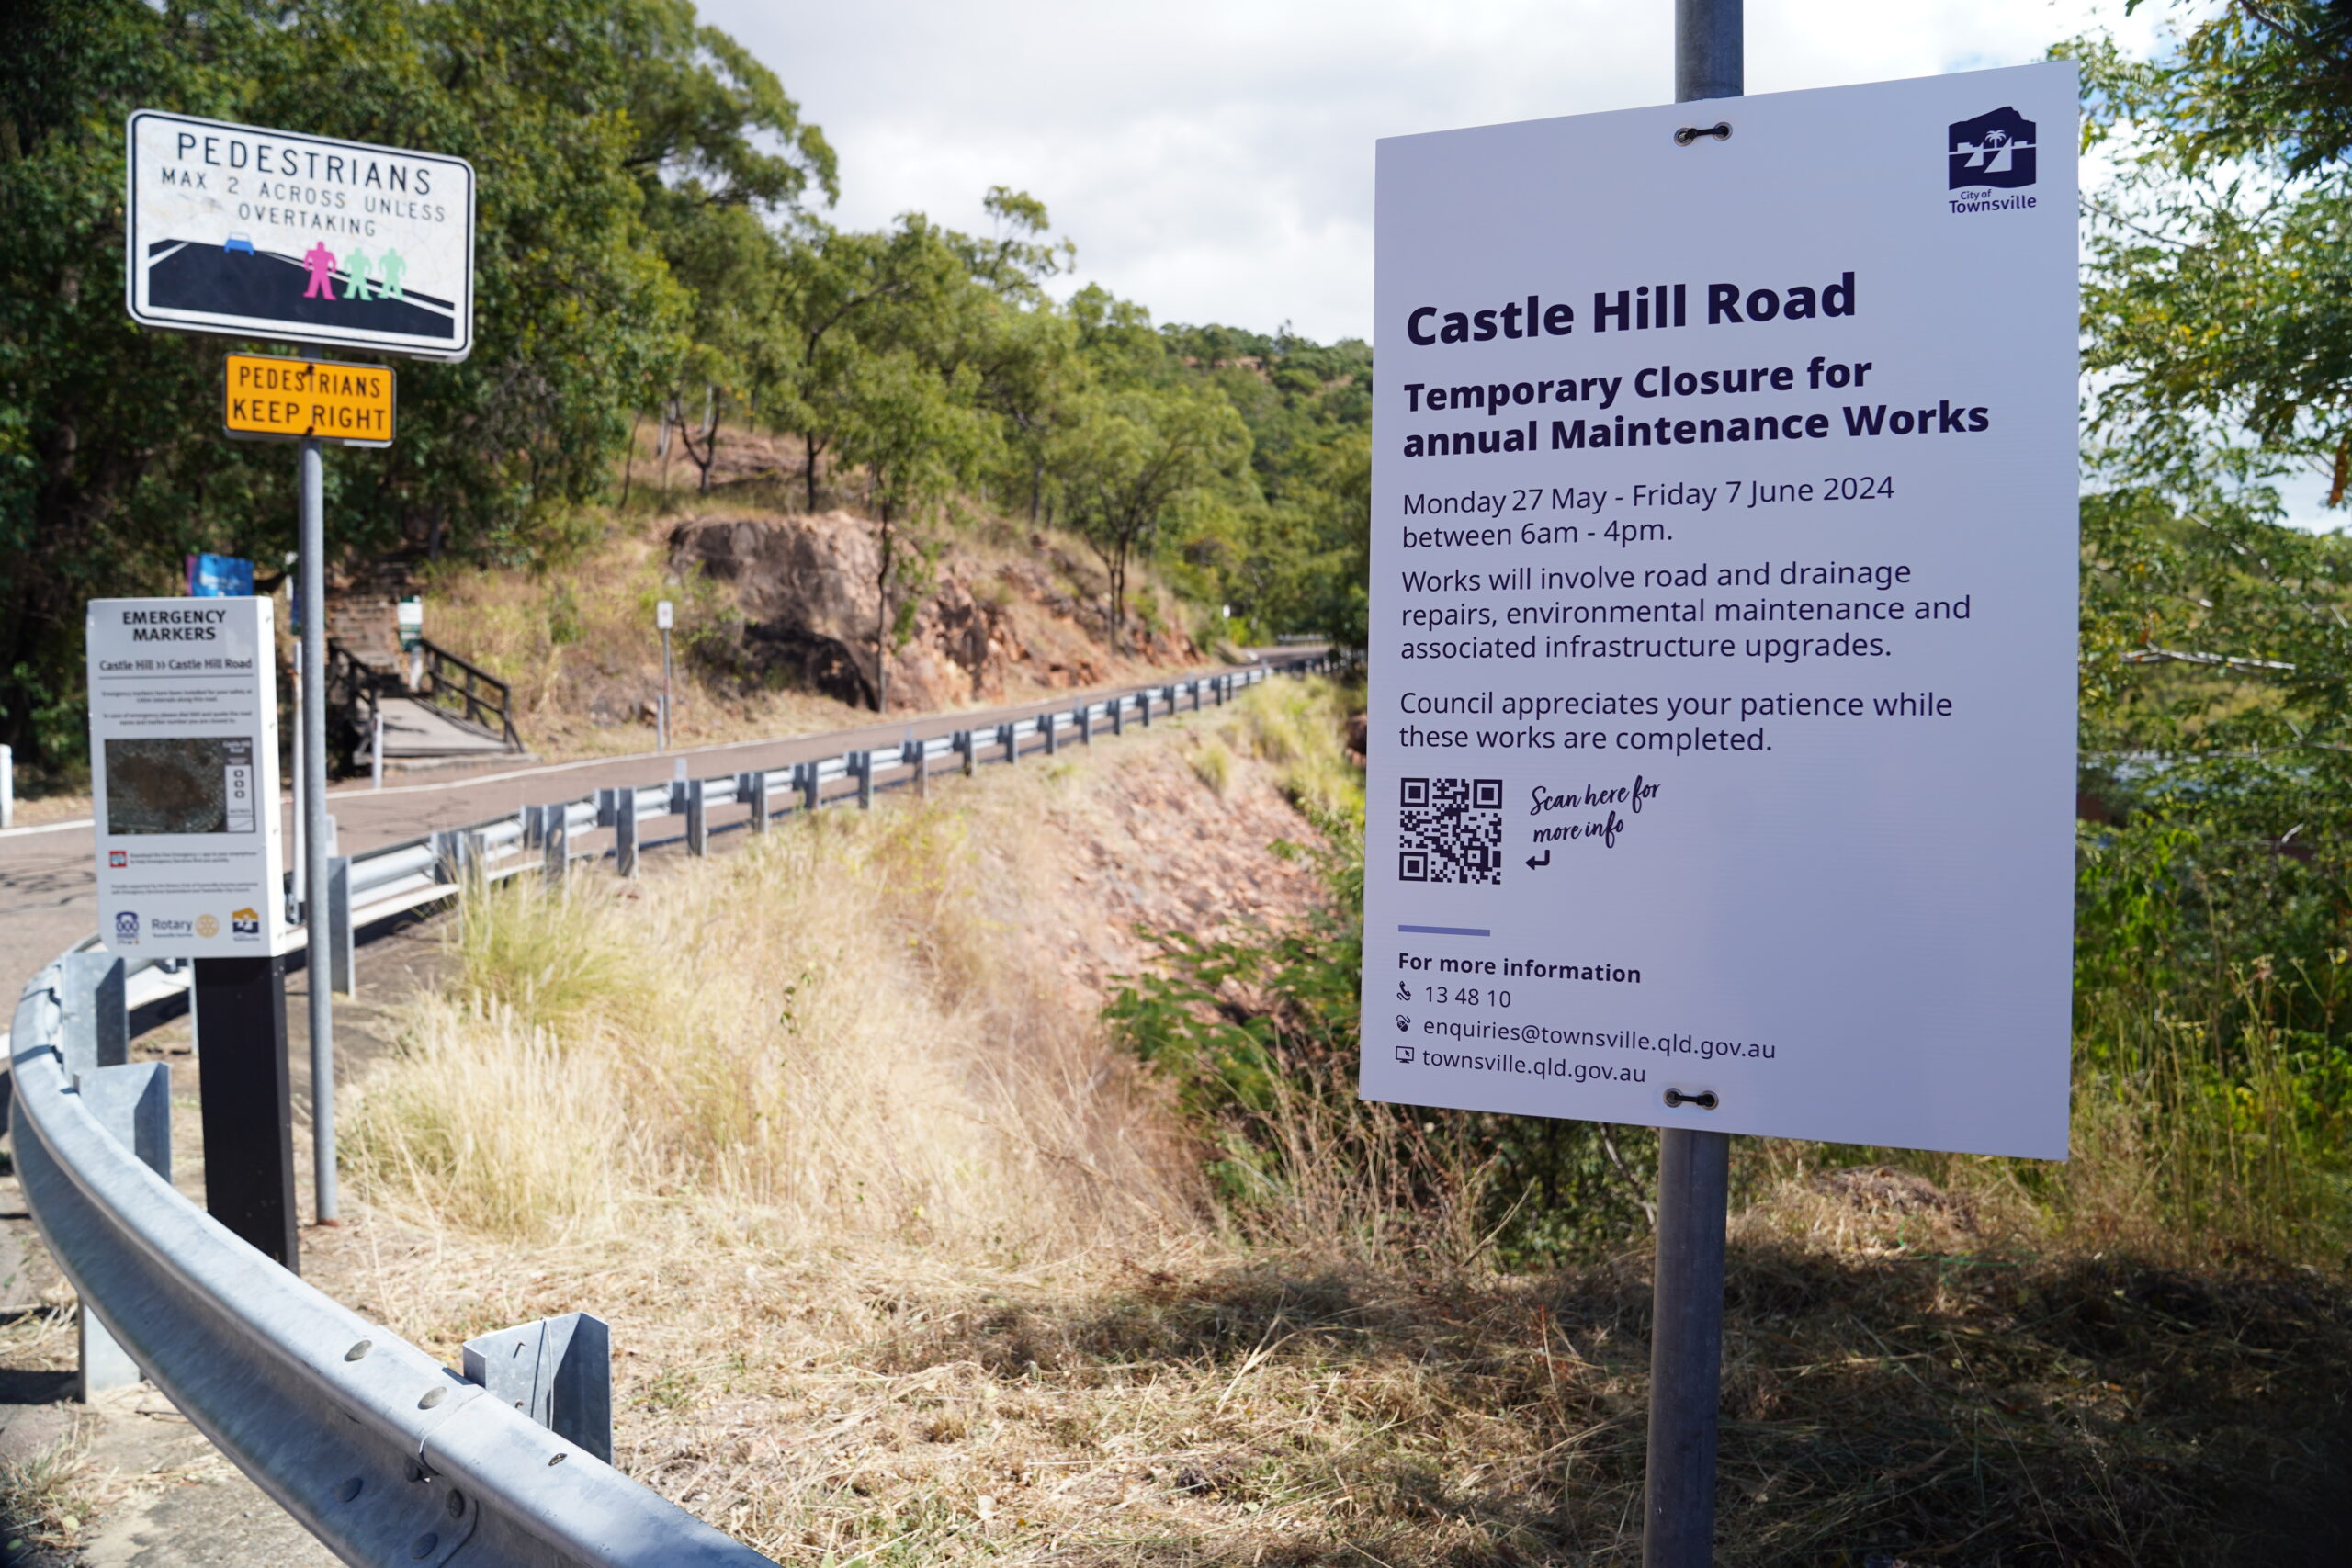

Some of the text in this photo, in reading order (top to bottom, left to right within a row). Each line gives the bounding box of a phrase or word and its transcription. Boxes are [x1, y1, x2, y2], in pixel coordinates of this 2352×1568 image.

[177, 132, 432, 195] PEDESTRIANS
[162, 167, 445, 223] MAX 2 ACROSS UNLESS
[1949, 194, 2036, 213] Townsville
[1961, 189, 1992, 201] City of
[238, 202, 376, 236] OVERTAKING
[1408, 272, 1855, 345] Castle Hill Road
[239, 366, 380, 399] PEDESTRIANS
[1404, 357, 1872, 415] Temporary Closure for
[233, 399, 385, 431] KEEP RIGHT
[1404, 400, 1988, 457] annual Maintenance Works
[1405, 491, 1506, 518] Monday
[1512, 489, 1543, 511] 27
[1553, 488, 1607, 514] May
[1634, 482, 1717, 511] Friday
[1726, 481, 1741, 502] 7
[1747, 481, 1813, 508] June
[1824, 476, 1894, 500] 2024
[1404, 526, 1510, 547] between
[1521, 523, 1577, 544] 6am
[1604, 520, 1672, 547] 4pm.
[1402, 561, 1910, 592] Works will involve road and drainage
[123, 610, 225, 625] EMERGENCY
[1403, 595, 1970, 631] repairs, environmental maintenance and
[133, 627, 216, 641] MARKERS
[1402, 633, 1891, 663] associated infrastructure upgrades.
[99, 660, 133, 671] Castle
[135, 660, 153, 670] Hill
[168, 660, 202, 670] Castle
[204, 659, 222, 669] Hill
[224, 659, 252, 669] Road
[1401, 692, 1951, 722] Council appreciates your patience while
[1399, 725, 1771, 756] these works are completed.
[1531, 775, 1660, 816] Scan here for
[1533, 810, 1623, 848] more info
[152, 919, 192, 931] Rotary
[1399, 953, 1640, 983] For more information
[1426, 987, 1510, 1008] 13 48 10
[1422, 1021, 1776, 1059] enquiries@townsville.qld.gov.au
[1423, 1051, 1645, 1083] townsville.qld.gov.au
